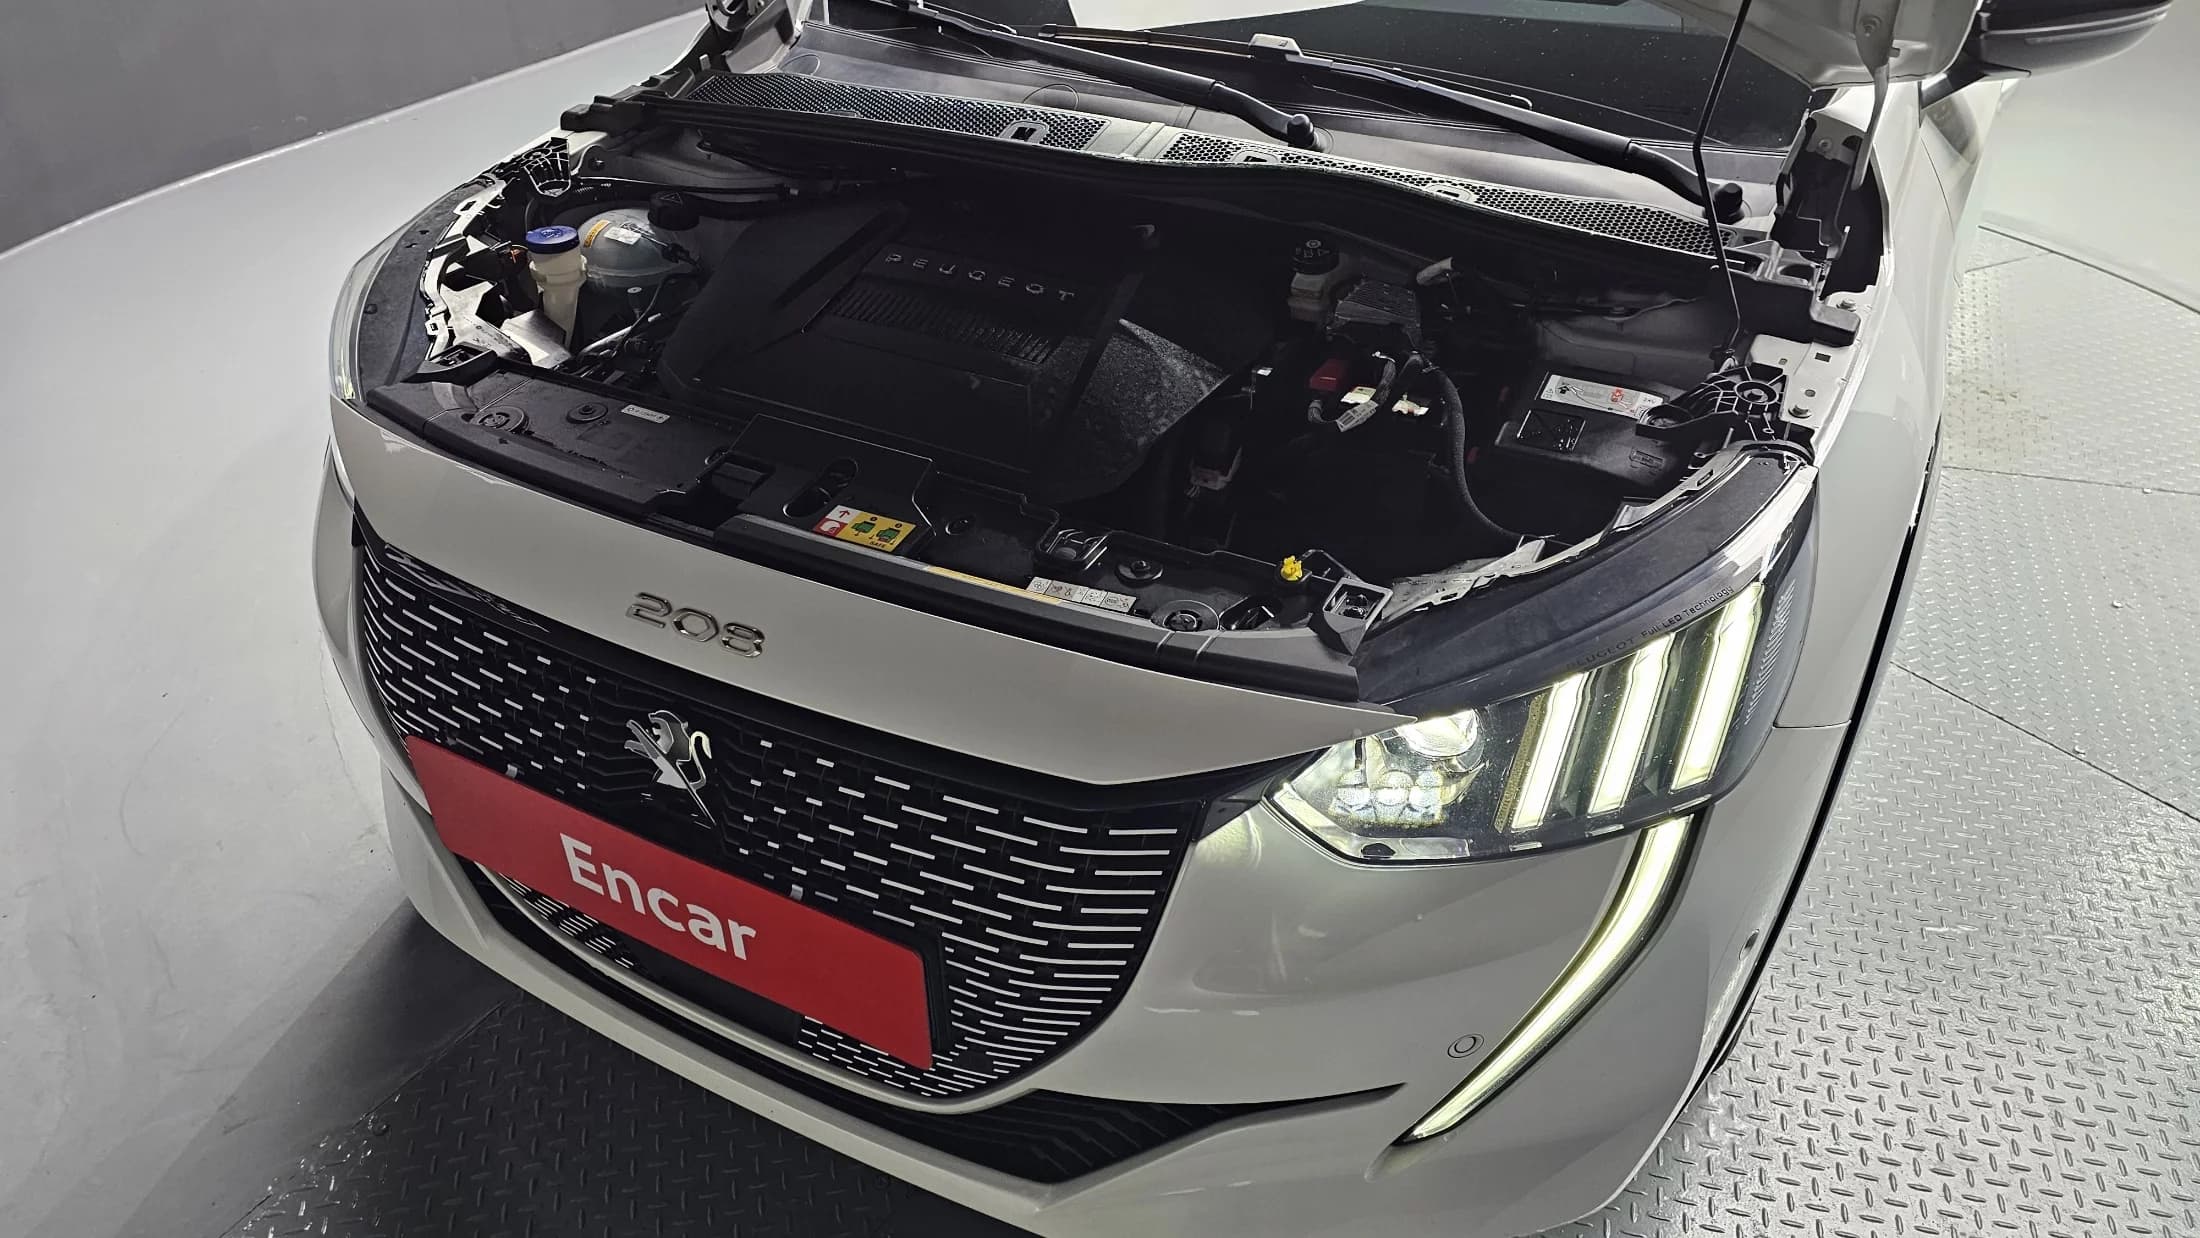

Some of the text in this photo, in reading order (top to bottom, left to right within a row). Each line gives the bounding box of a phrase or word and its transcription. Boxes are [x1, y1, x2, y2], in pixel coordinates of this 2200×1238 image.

[885, 254, 1075, 301] PEUGEOT
[625, 592, 766, 659] 208
[1640, 625, 1660, 638] Full
[1661, 613, 1683, 629] LED
[1683, 586, 1735, 618] Technology
[559, 832, 758, 961] Encar
